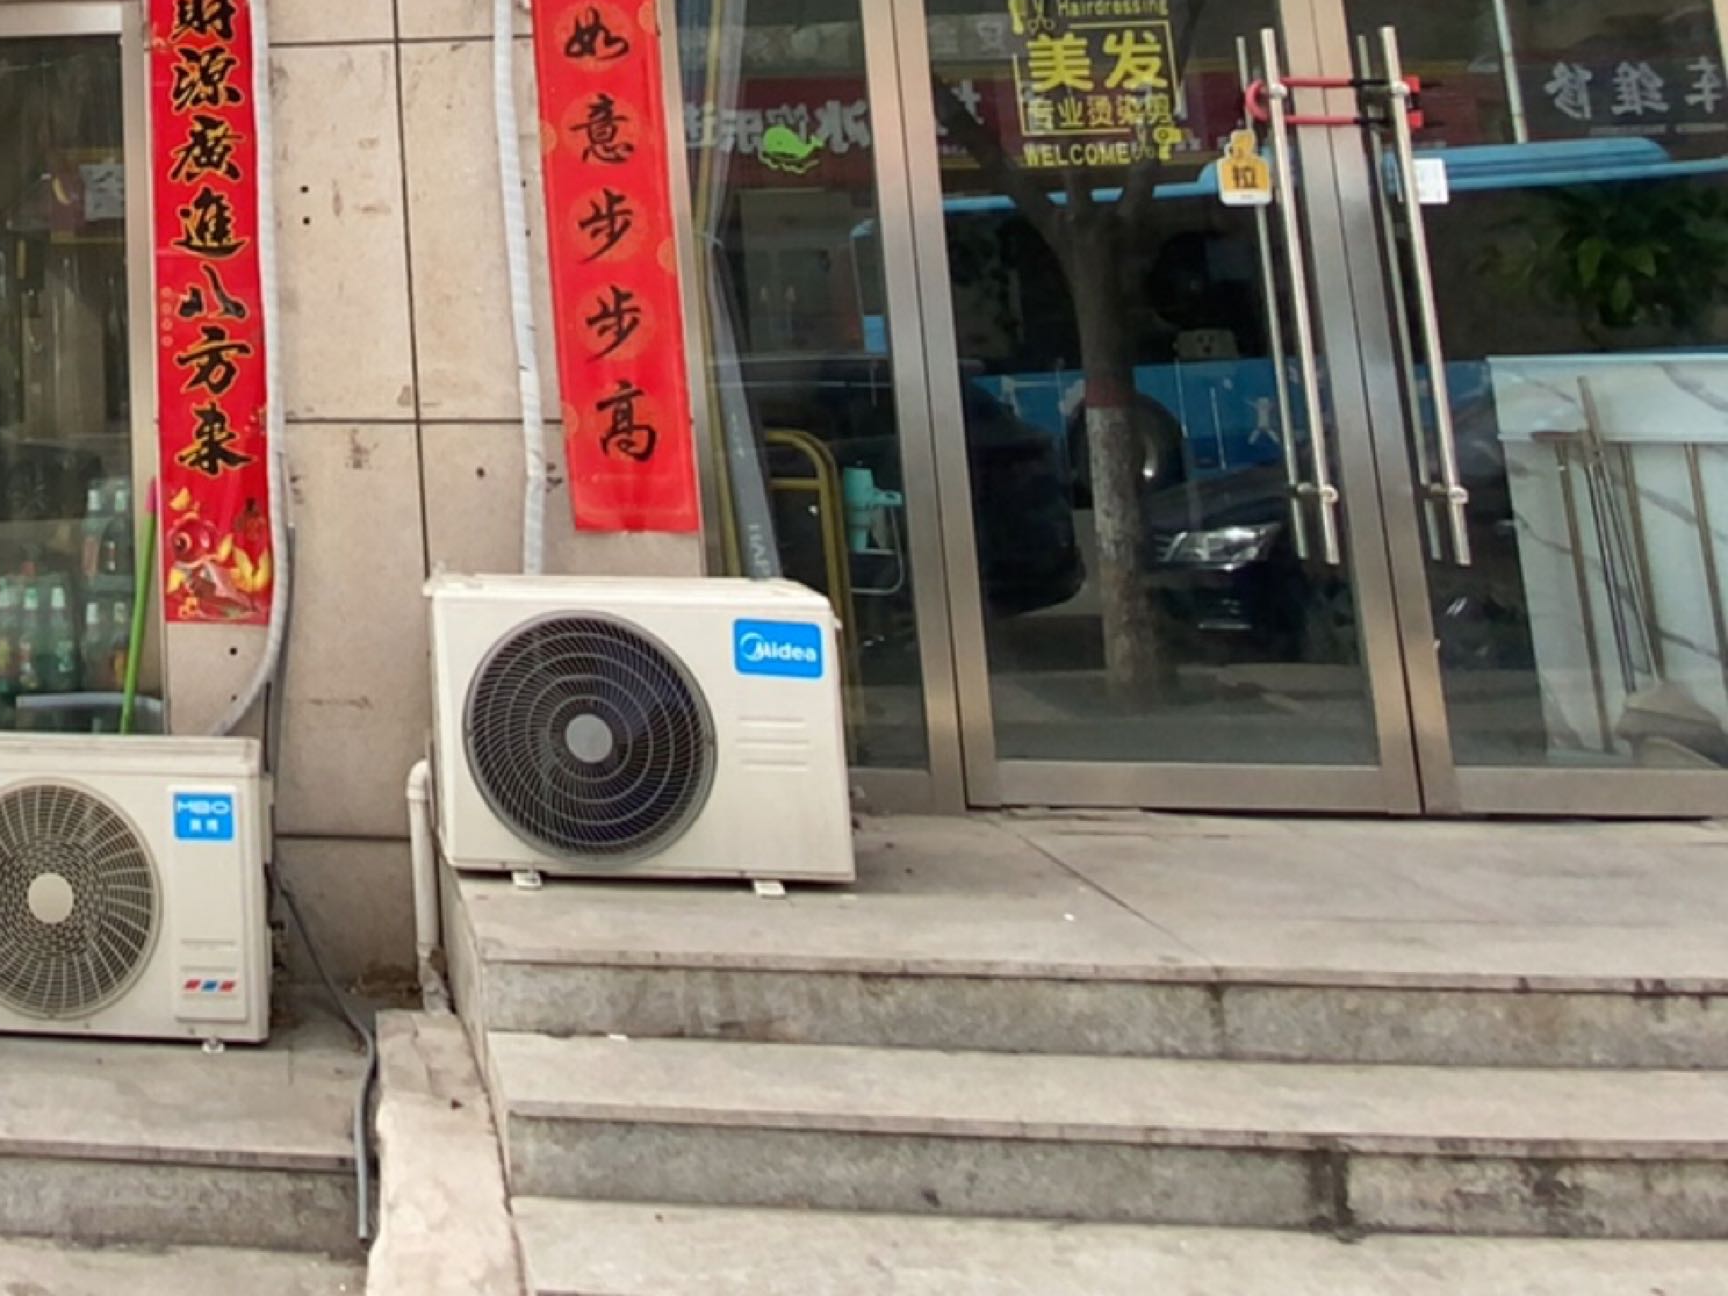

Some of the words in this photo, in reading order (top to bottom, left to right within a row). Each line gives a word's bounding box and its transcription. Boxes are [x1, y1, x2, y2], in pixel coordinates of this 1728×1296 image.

[1027, 29, 1168, 93] 美发
[1022, 141, 1131, 168] WELCOME
[739, 631, 819, 665] Midea
